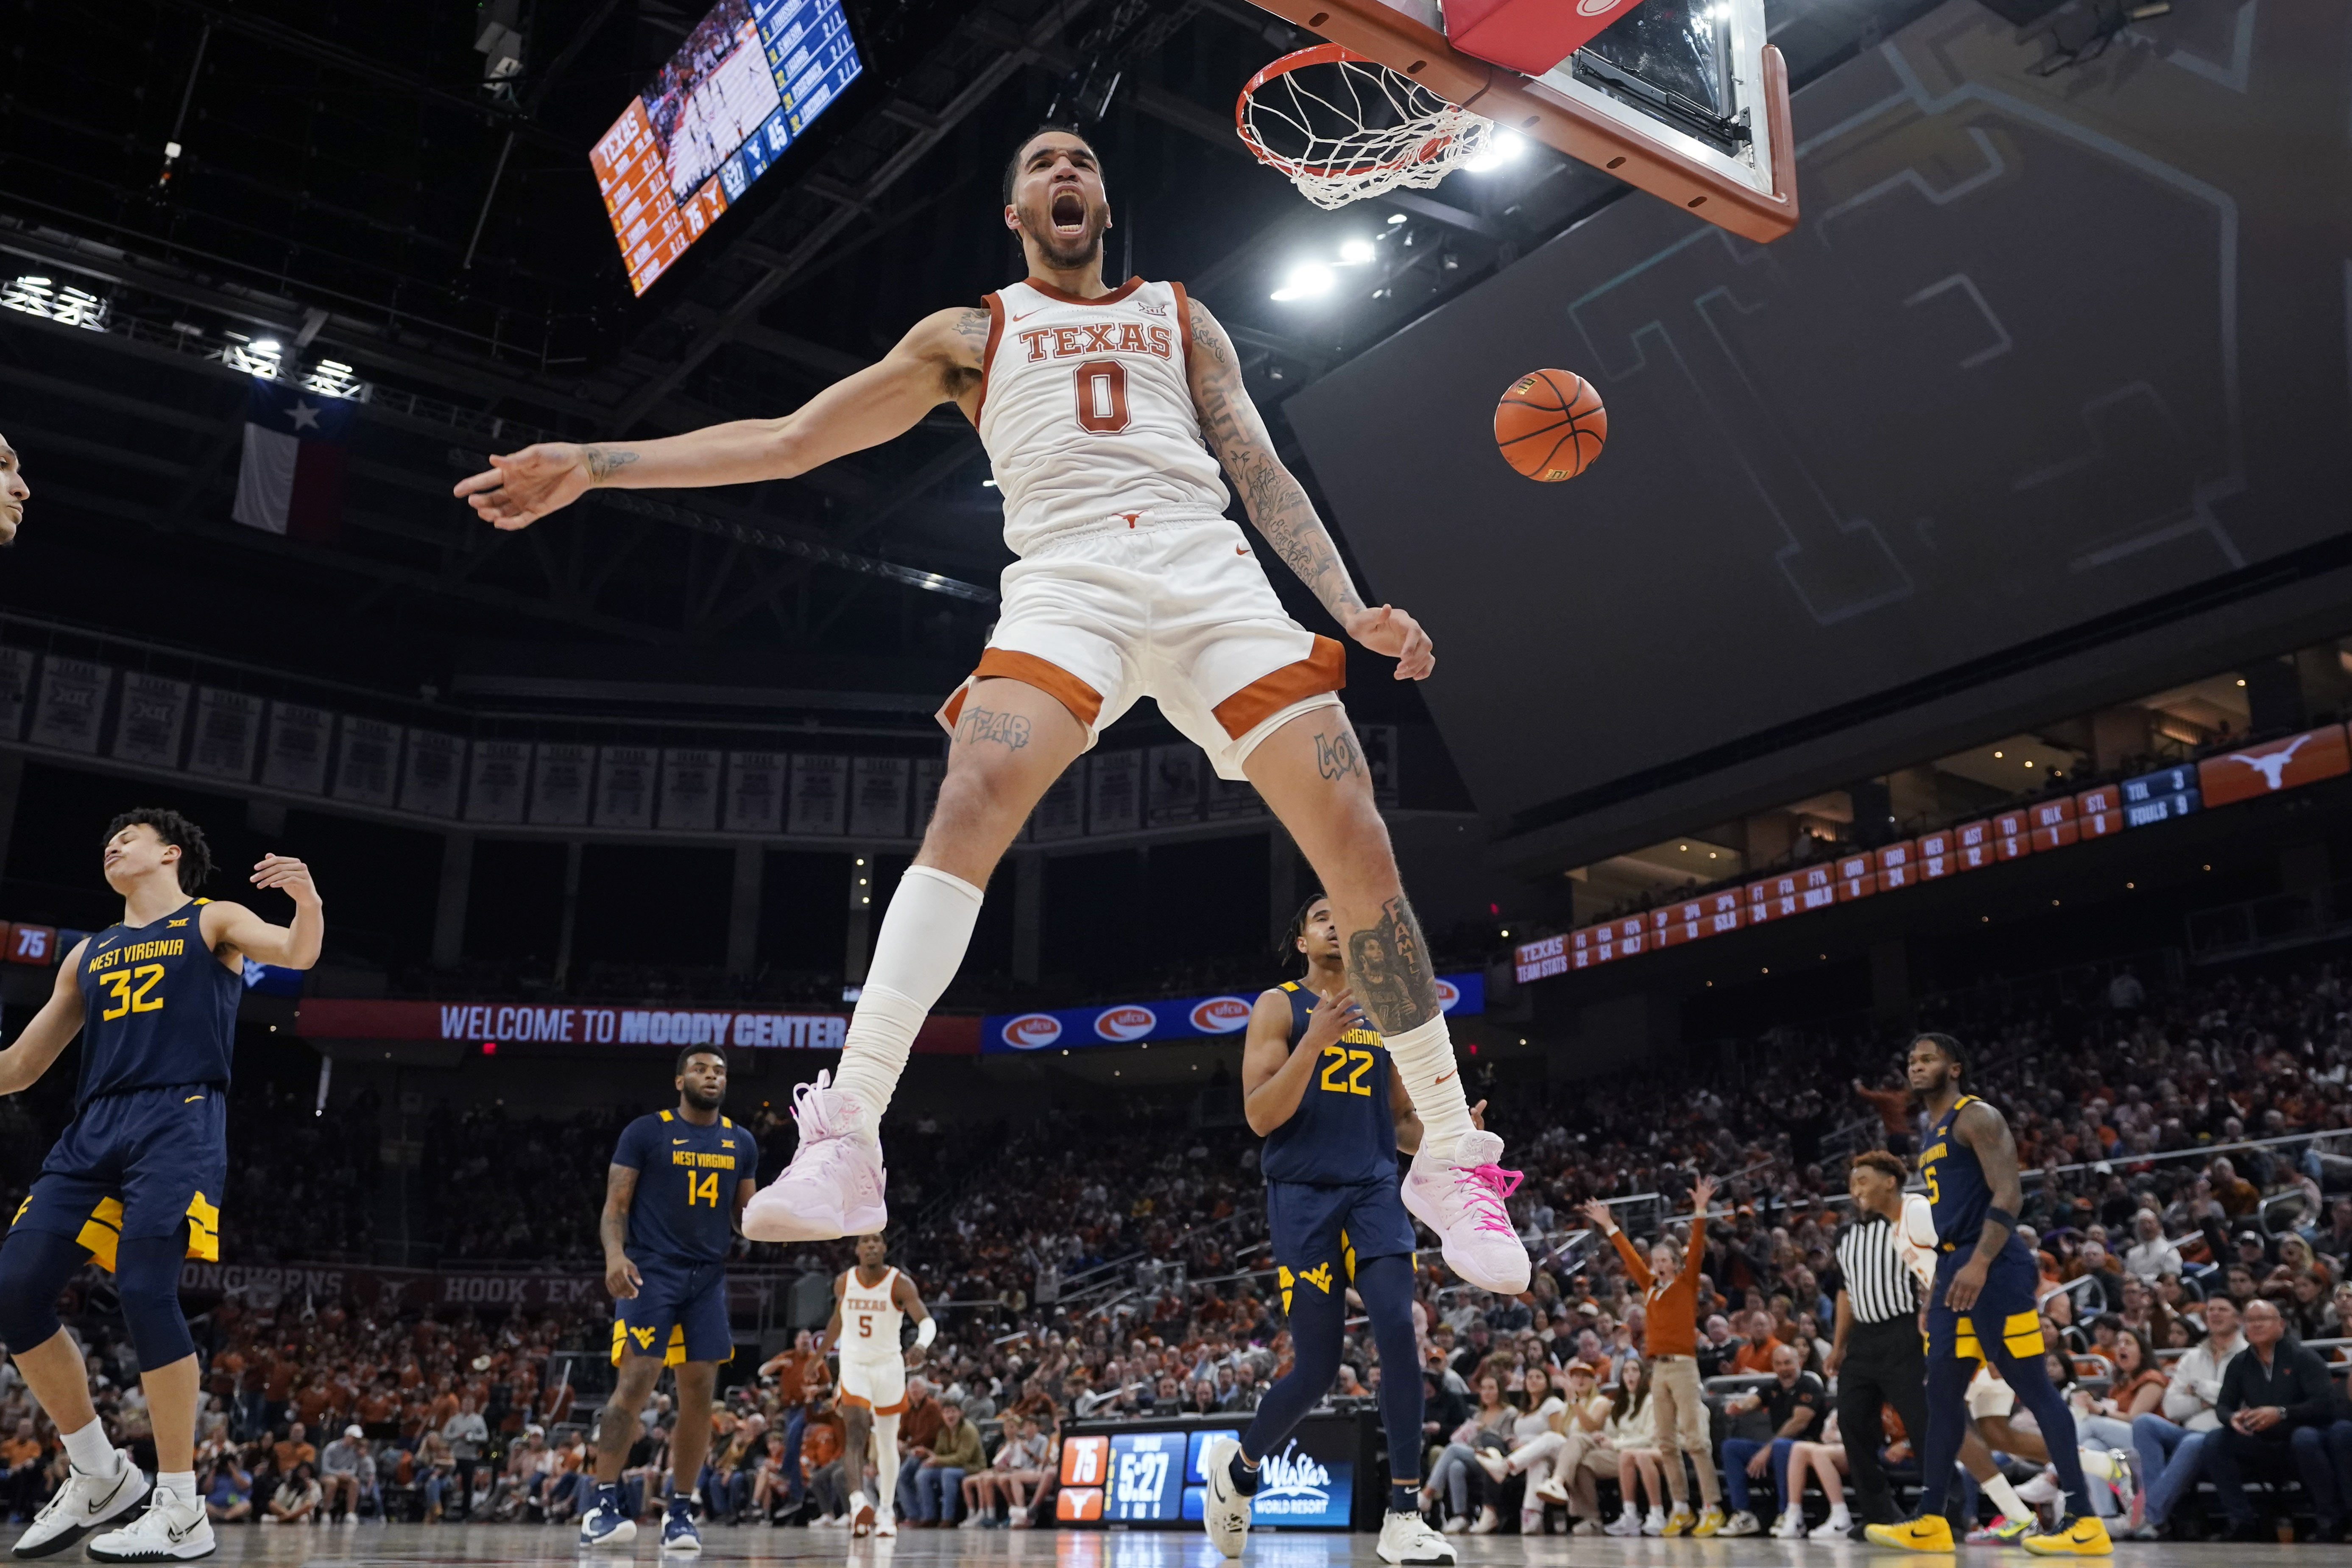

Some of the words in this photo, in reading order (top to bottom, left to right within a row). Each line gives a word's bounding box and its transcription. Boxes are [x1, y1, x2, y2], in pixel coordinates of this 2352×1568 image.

[598, 111, 639, 167] TEXAS
[767, 116, 787, 151] 45
[685, 201, 705, 236] 75
[1019, 323, 1172, 363] TEXAS
[1073, 359, 1131, 435] 0
[18, 928, 46, 958] 75
[88, 948, 122, 974] WEST
[123, 939, 184, 963] VIRGINIA
[1521, 936, 1564, 963] TEXAS
[1540, 954, 1568, 977] STATS
[99, 963, 165, 1021] 32
[440, 1005, 576, 1041] WELCOME
[582, 1010, 616, 1043] TO
[618, 1010, 732, 1045] MOODY
[733, 1013, 846, 1049] CENTER
[1320, 1046, 1374, 1097] 22
[672, 1150, 696, 1166] WEST
[697, 1153, 735, 1170] VIRGINIA
[687, 1169, 719, 1208] 14
[445, 1277, 530, 1303] HOOK
[847, 1298, 887, 1312] TEXAS
[859, 1315, 873, 1338] 5
[1072, 1439, 1099, 1483] 75
[1117, 1452, 1169, 1502] 5:27
[1258, 1437, 1331, 1488] WinStar
[1254, 1499, 1290, 1515] WORLD
[1290, 1498, 1329, 1515] RESORT
